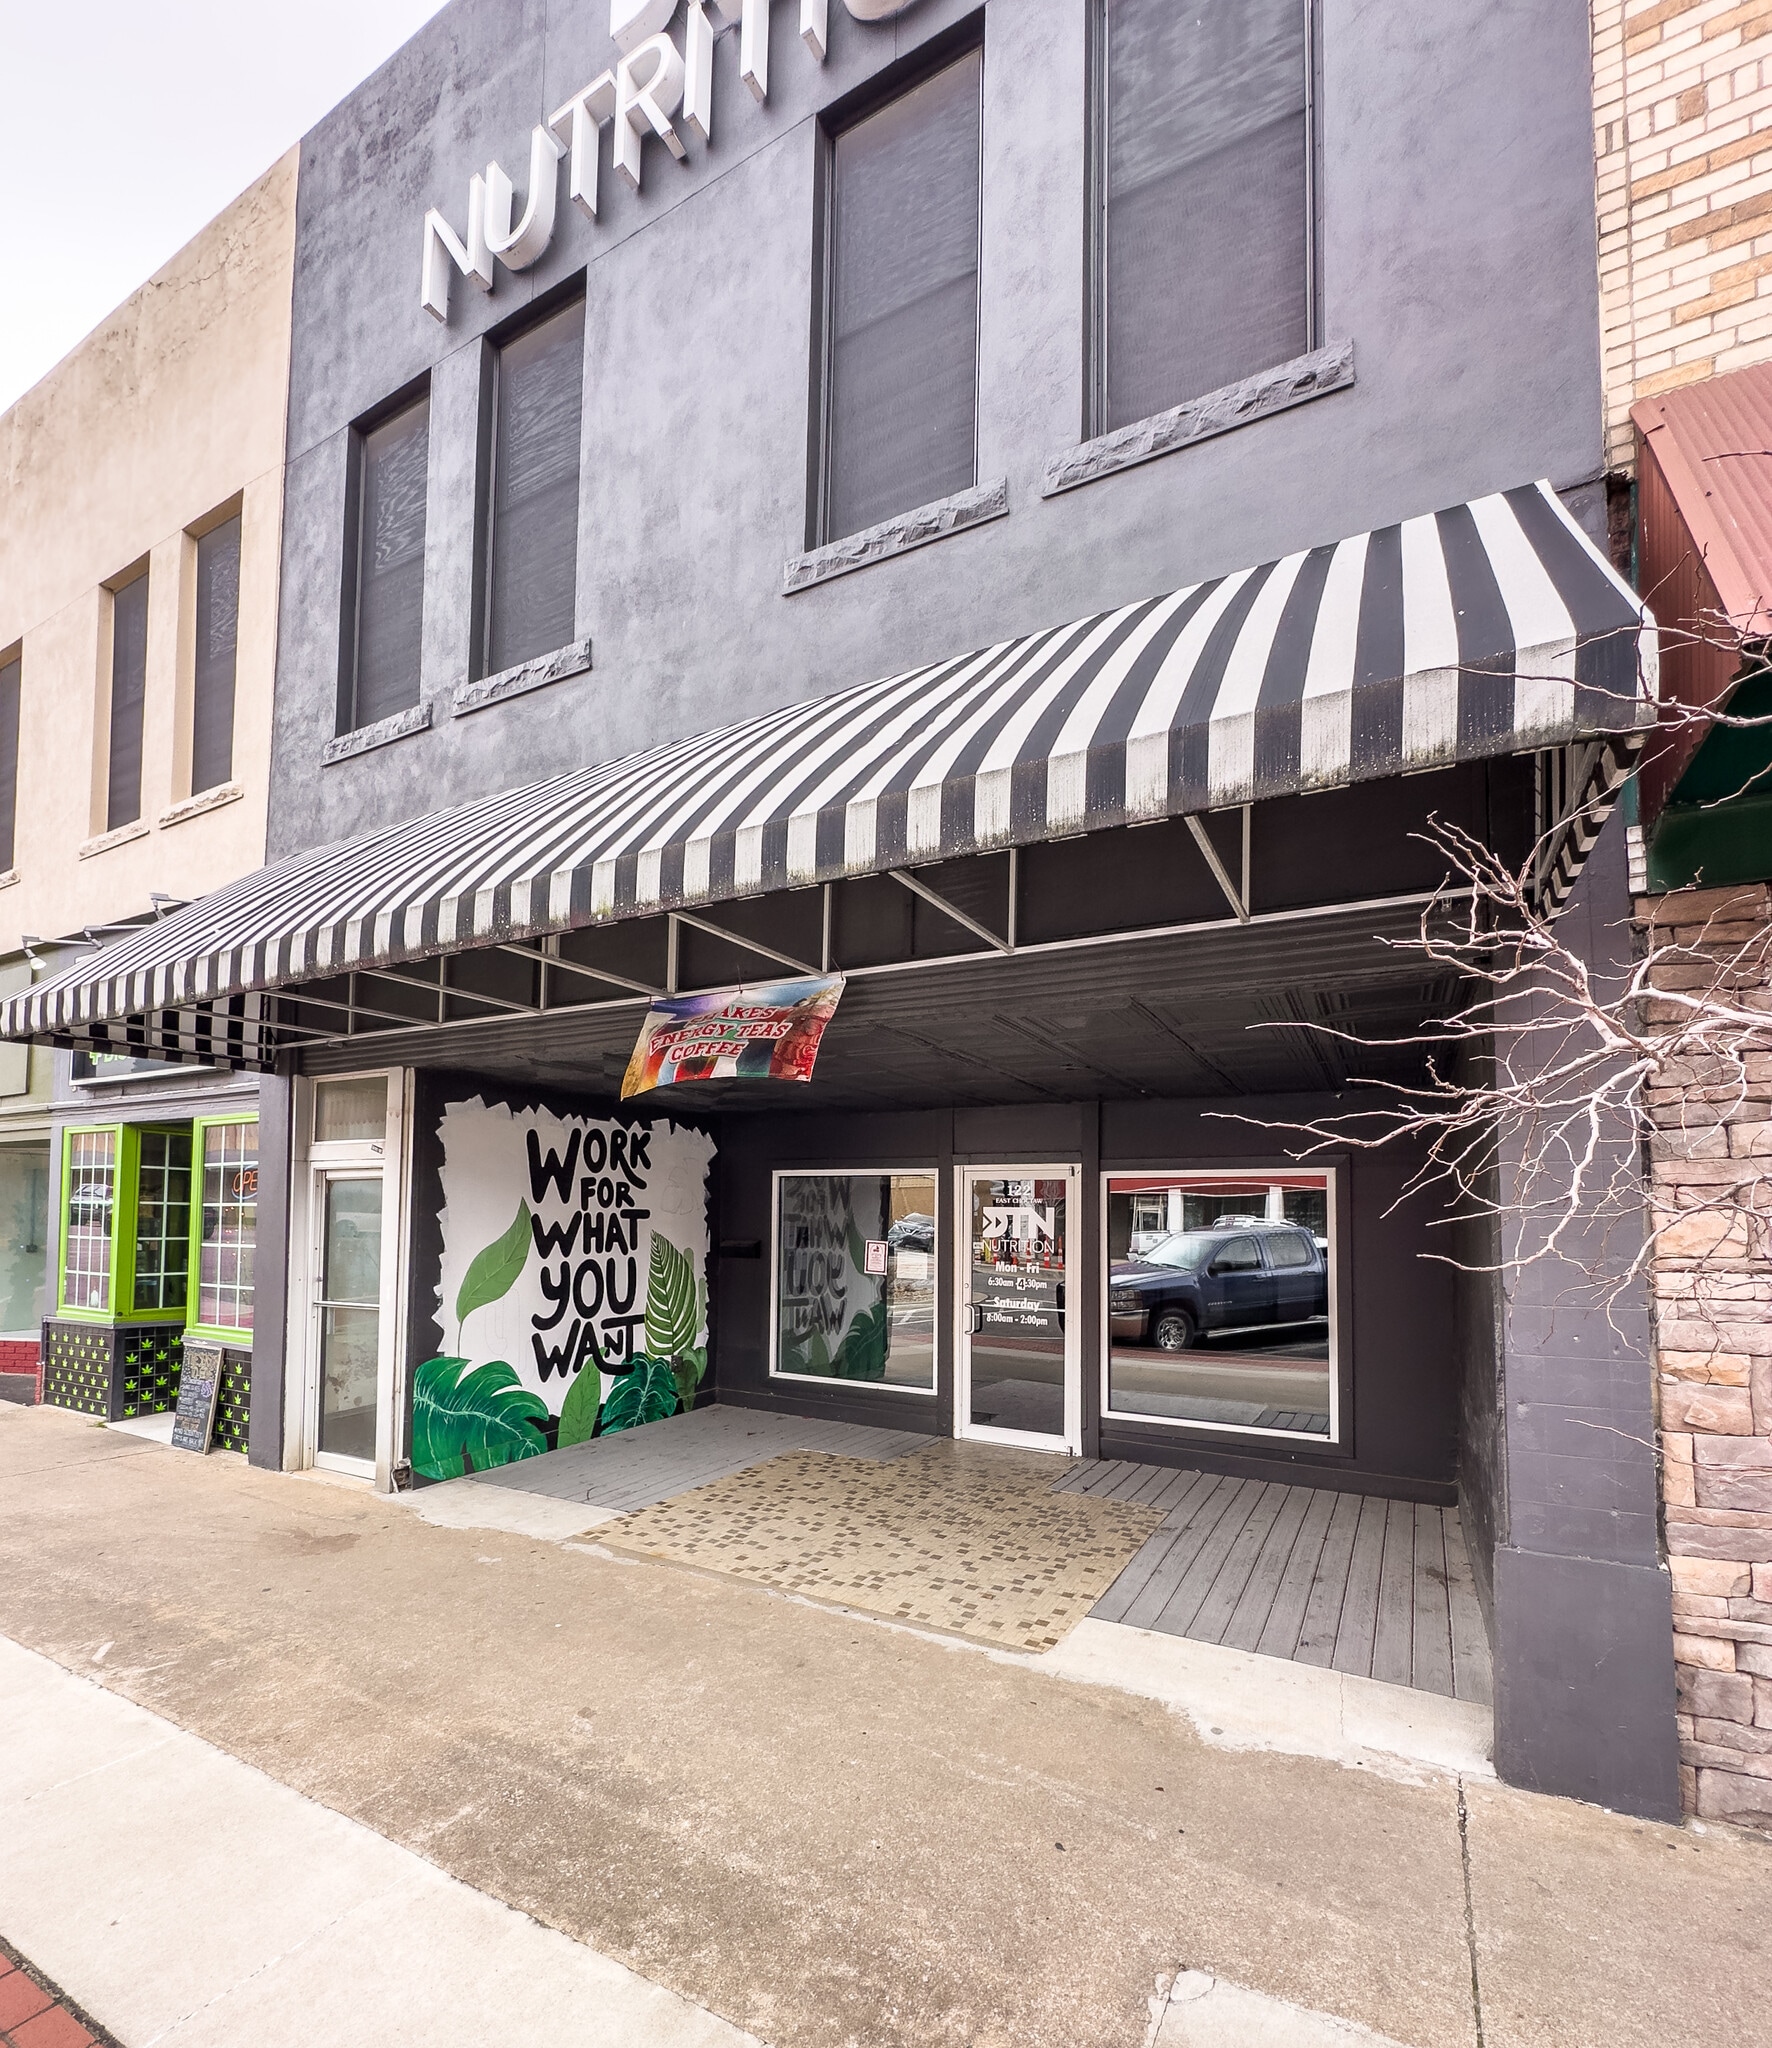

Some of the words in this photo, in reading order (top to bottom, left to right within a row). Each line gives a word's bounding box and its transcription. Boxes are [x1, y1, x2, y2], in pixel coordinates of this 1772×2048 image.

[650, 1022, 733, 1052] ENERGY
[735, 1022, 790, 1038] TEAS
[671, 1040, 747, 1062] COFFEE
[526, 1128, 651, 1204] WORK
[580, 1177, 636, 1211] FOR
[1006, 1184, 1031, 1197] 122
[531, 1208, 651, 1260] WHAT
[982, 1206, 1055, 1240] DTN
[983, 1239, 1055, 1254] NUTRITION
[995, 1261, 1018, 1273] Mon
[1026, 1261, 1040, 1274] Fri
[987, 1276, 1014, 1287] 6:30am
[1017, 1278, 1048, 1291] 4:30pm
[993, 1296, 1041, 1312] Saturday
[986, 1313, 1014, 1323] 8:00am
[1020, 1314, 1048, 1327] 2:00pm
[531, 1313, 647, 1383] WANT
